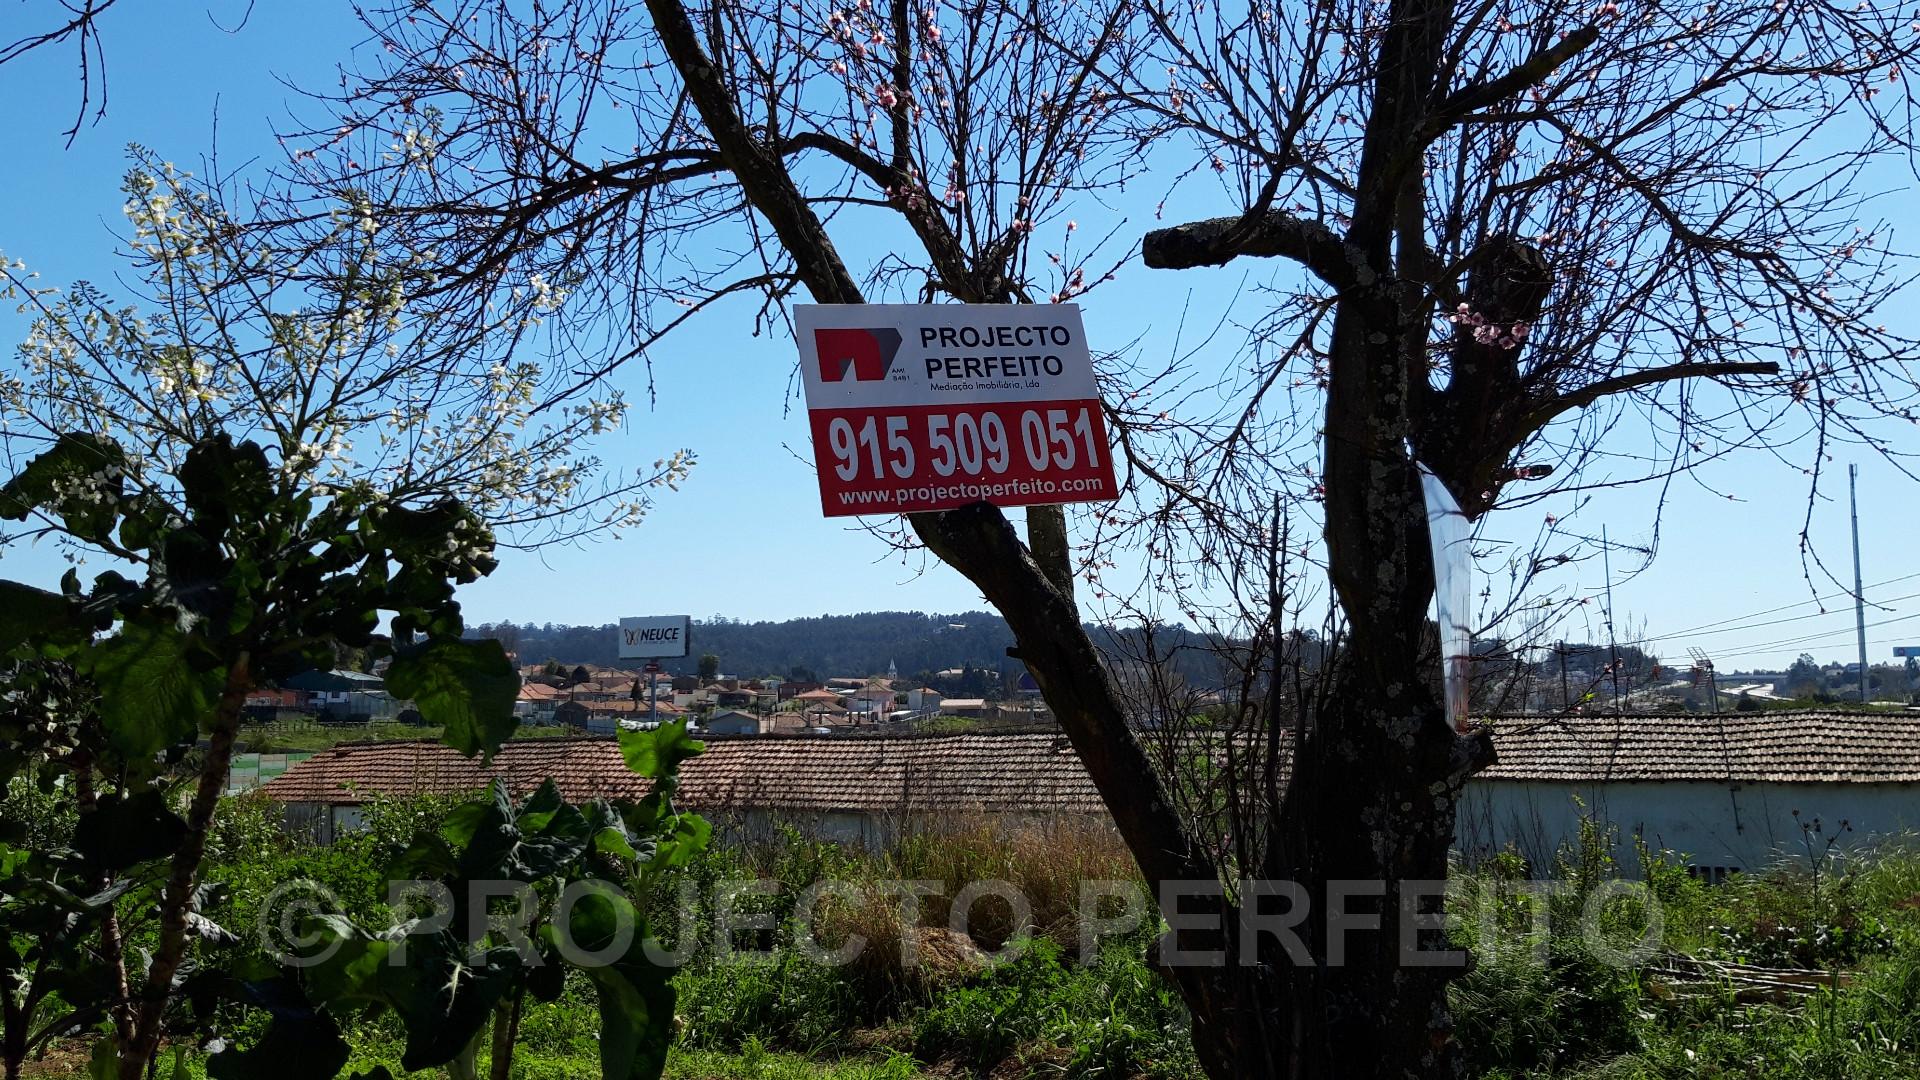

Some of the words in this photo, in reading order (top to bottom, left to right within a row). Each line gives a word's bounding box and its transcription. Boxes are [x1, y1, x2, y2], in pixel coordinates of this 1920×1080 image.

[920, 325, 1070, 348] PROJECTO
[925, 355, 1063, 379] PERFEITO
[930, 381, 973, 392] Mediação
[975, 380, 1023, 391] Imobiliária,
[1025, 380, 1040, 389] Lda
[829, 416, 915, 481] 915
[927, 411, 1009, 477] 509
[1021, 408, 1099, 471] 051
[839, 477, 1103, 504] www.projectoperfeito.com
[641, 628, 680, 641] NEUCE
